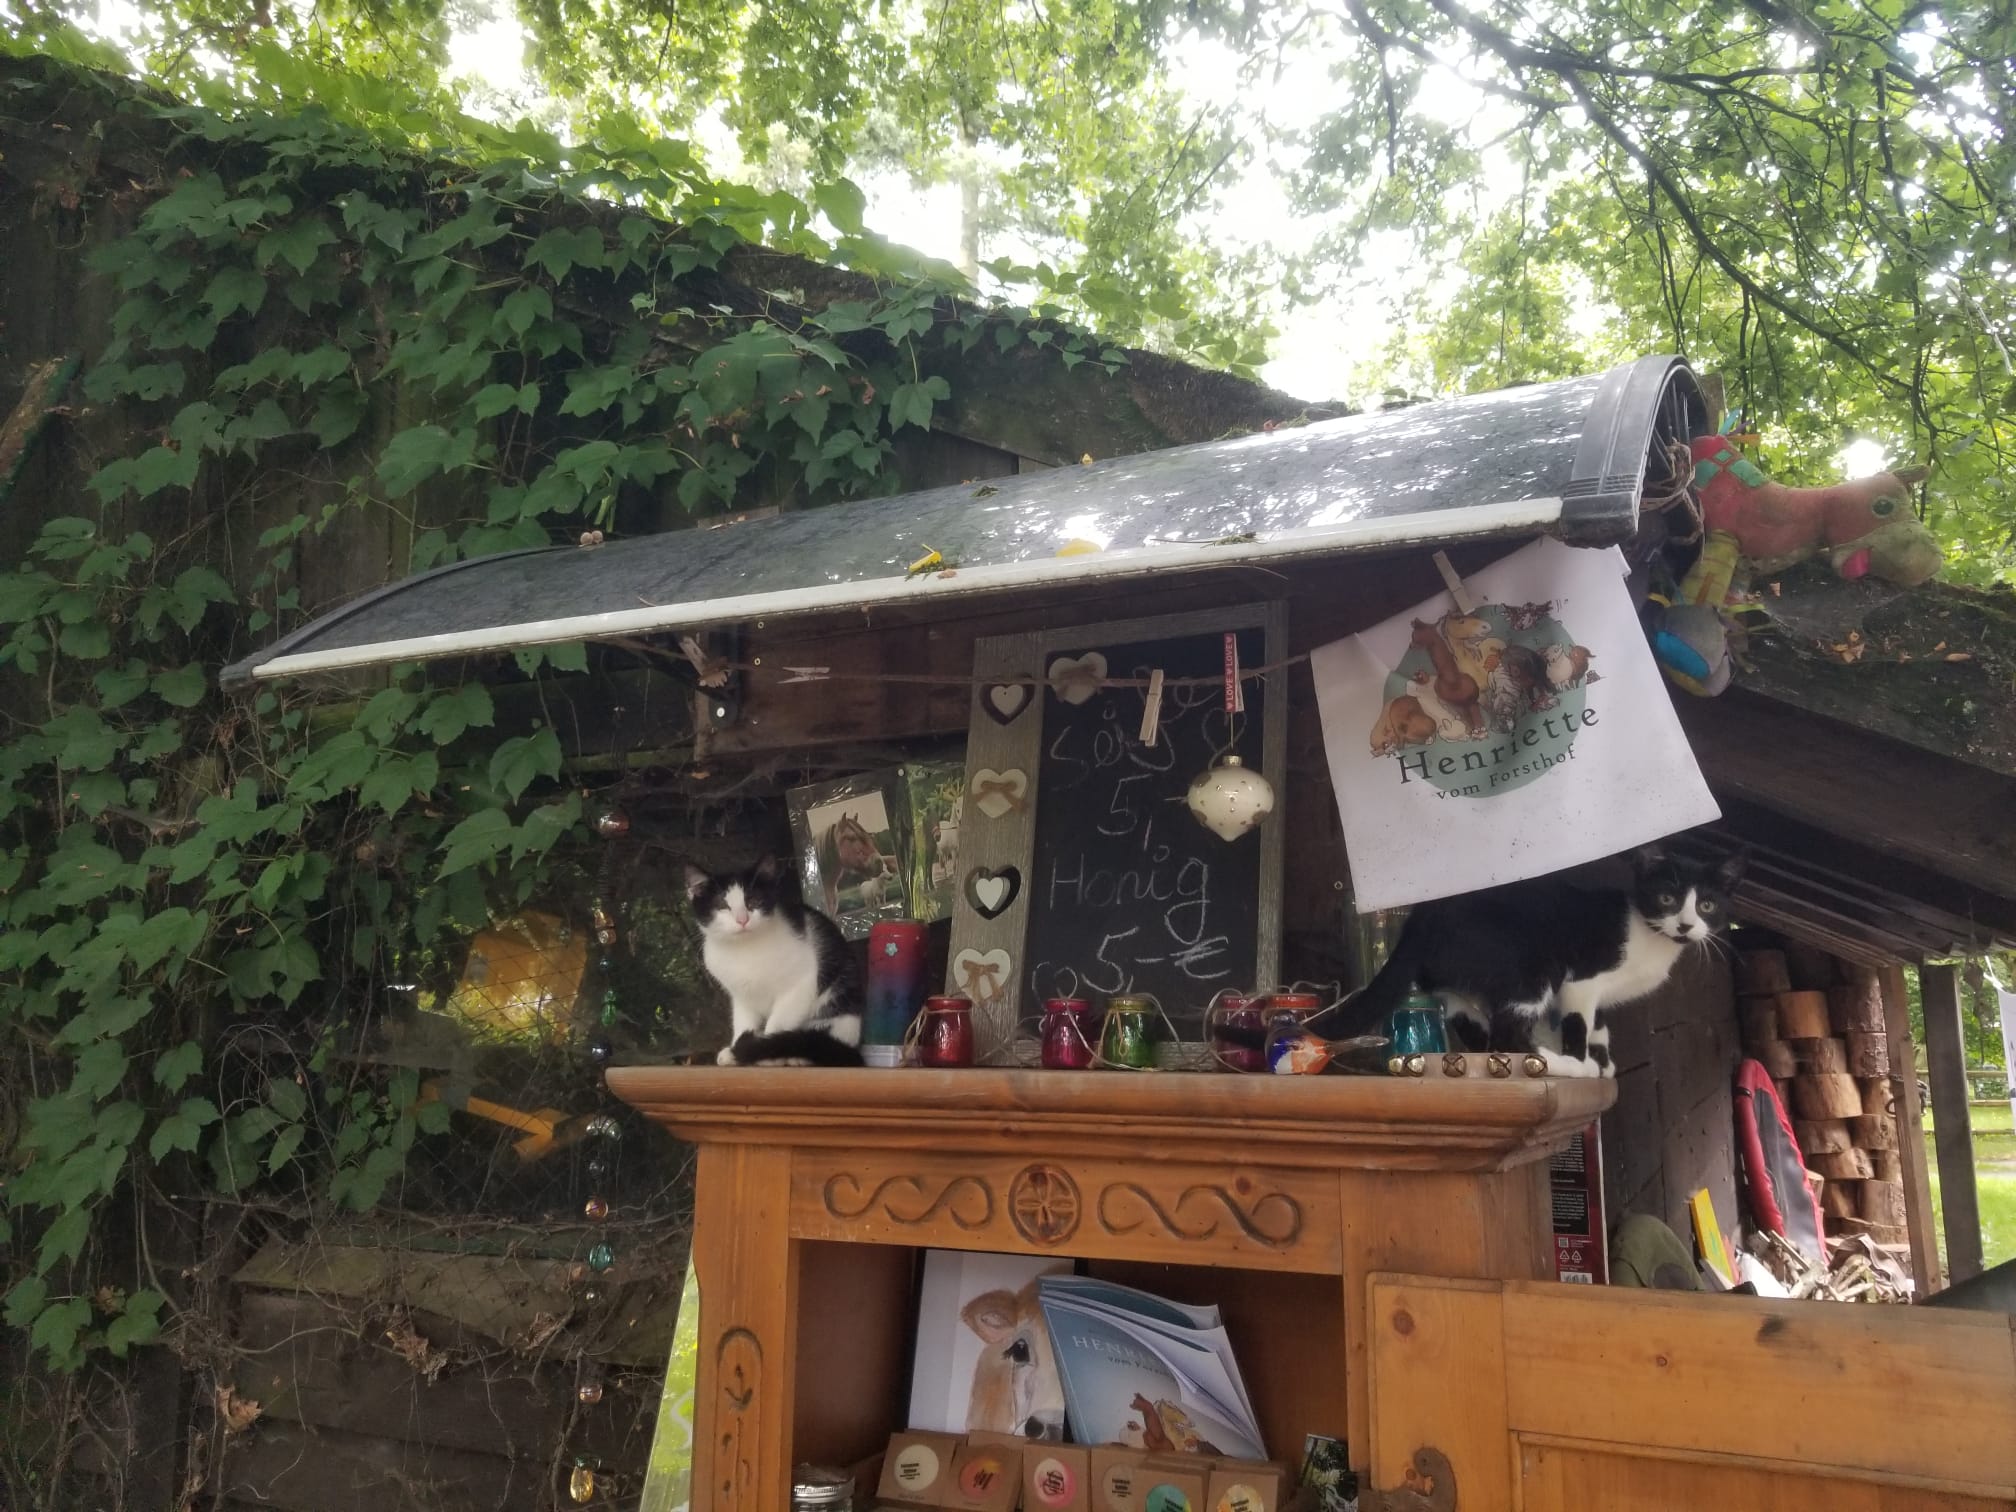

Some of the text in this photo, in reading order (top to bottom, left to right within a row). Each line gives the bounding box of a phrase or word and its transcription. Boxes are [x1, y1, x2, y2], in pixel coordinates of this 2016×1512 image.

[1225, 642, 1234, 702] LOVE LOVE
[1396, 707, 1600, 785] Henriette
[1436, 743, 1576, 800] vom Forsthof
[1050, 844, 1211, 945] Honig
